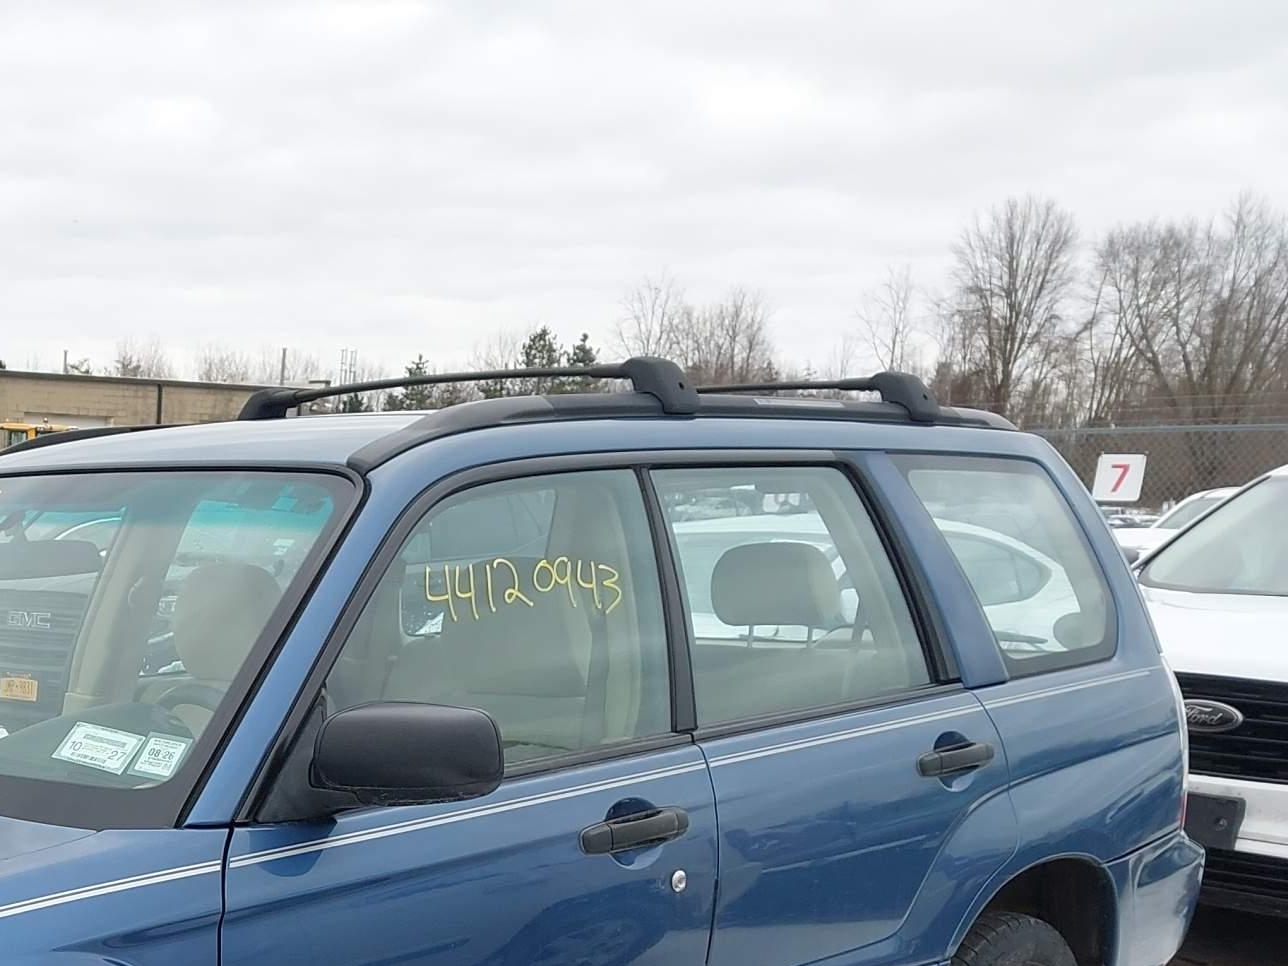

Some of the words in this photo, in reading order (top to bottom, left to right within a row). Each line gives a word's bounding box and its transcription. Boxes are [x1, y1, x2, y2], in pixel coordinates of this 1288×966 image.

[1111, 464, 1130, 492] 7
[424, 556, 622, 622] 44120943
[8, 611, 51, 629] GMC
